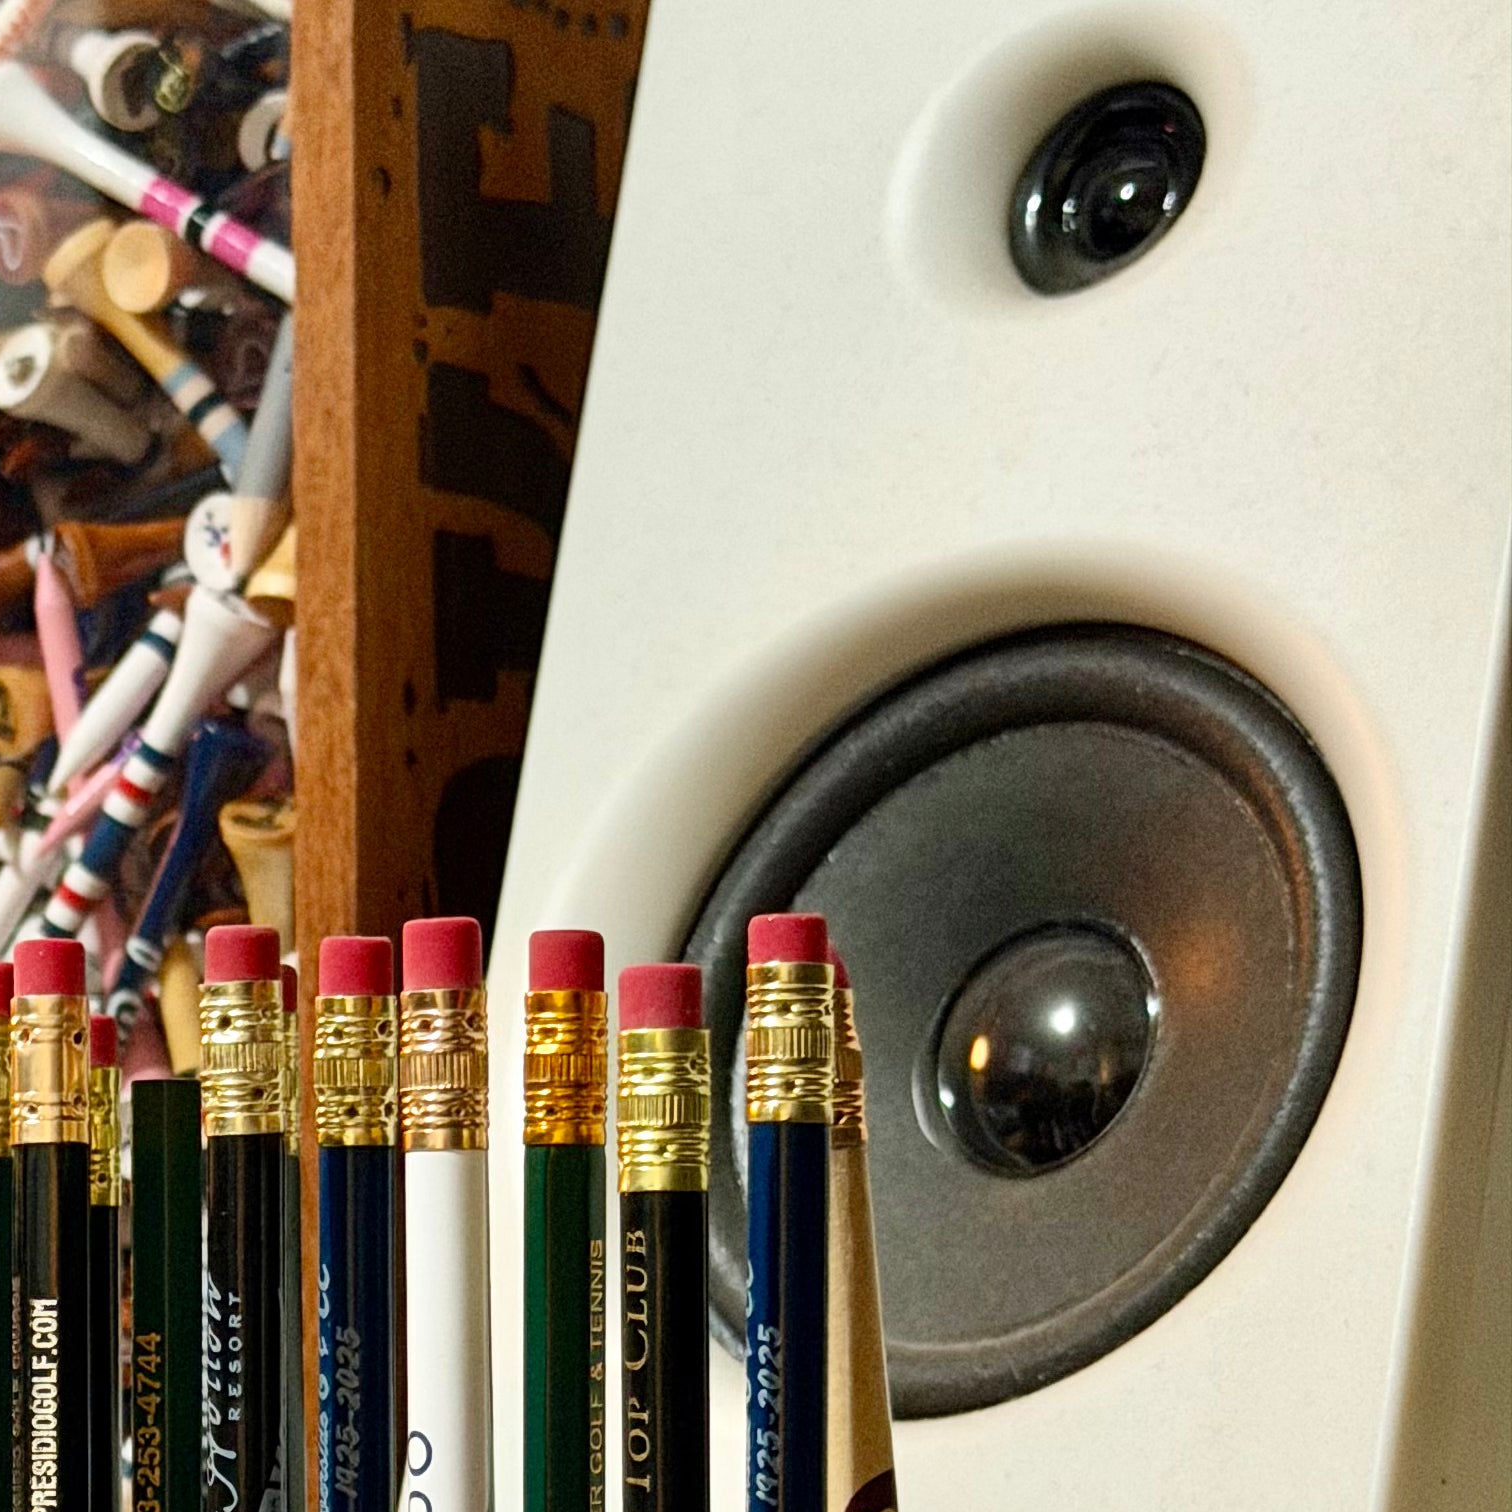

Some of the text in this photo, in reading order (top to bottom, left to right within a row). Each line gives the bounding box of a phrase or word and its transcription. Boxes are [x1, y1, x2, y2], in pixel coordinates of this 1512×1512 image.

[227, 1291, 243, 1422] RESORT
[590, 1239, 604, 1353] TENNIS
[624, 1229, 649, 1371] CLUB
[335, 1325, 361, 1500] 1925-2025
[590, 1361, 603, 1382] &
[756, 1323, 781, 1507] 1925-2025
[590, 1393, 604, 1475] GOLF
[625, 1396, 652, 1493] TOP
